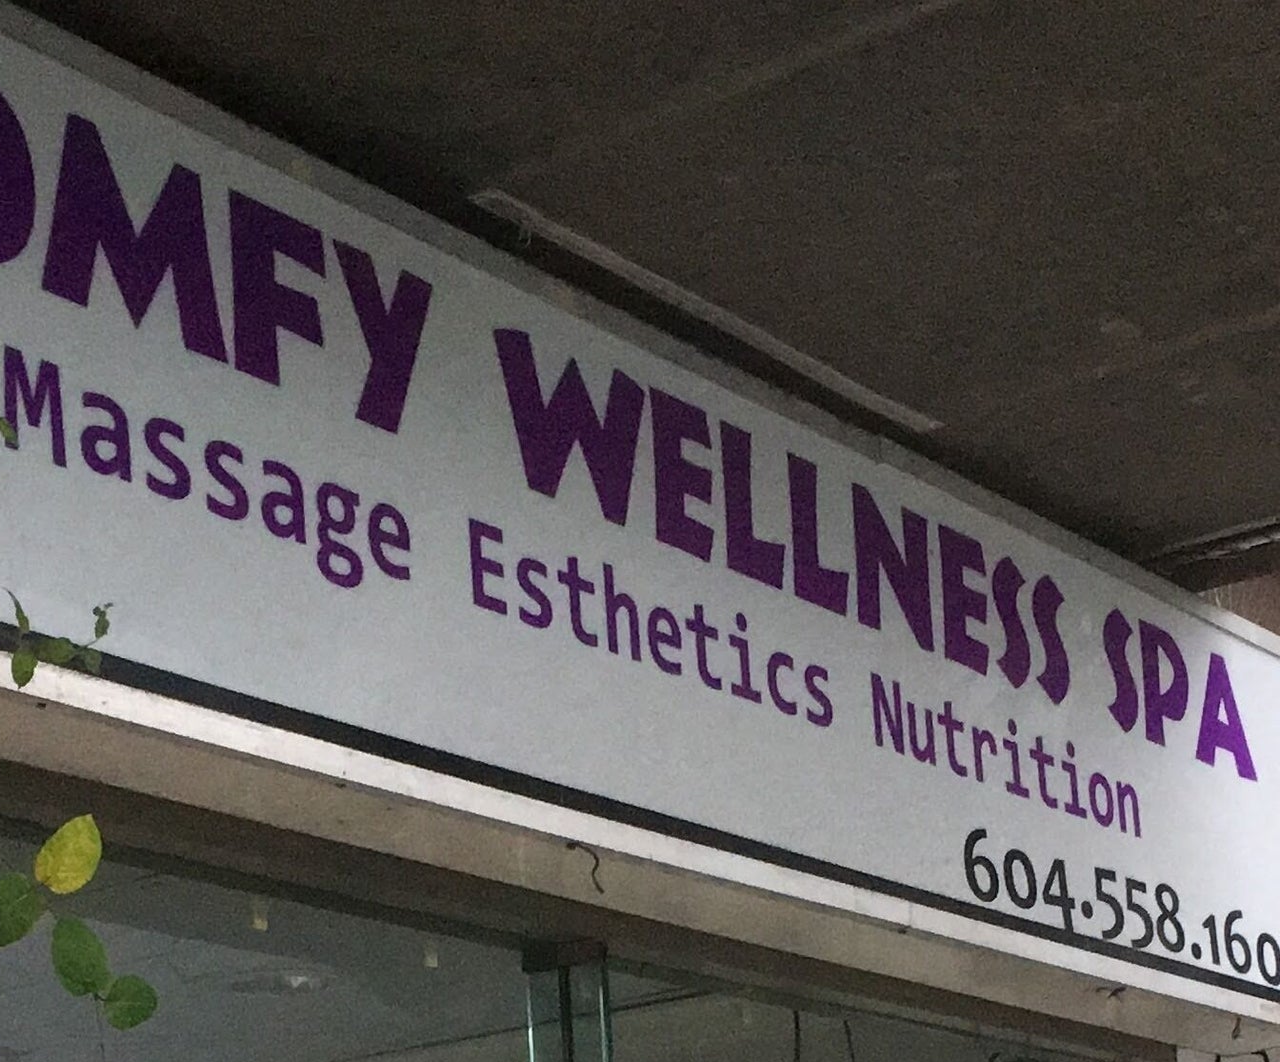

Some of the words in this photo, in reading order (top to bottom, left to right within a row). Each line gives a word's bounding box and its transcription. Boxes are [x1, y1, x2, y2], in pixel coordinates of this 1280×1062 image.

[3, 343, 411, 589] Massage
[467, 517, 835, 728] Esthetics
[871, 672, 1142, 838] Nutrition
[494, 327, 1071, 706] WELLNESS
[1104, 607, 1258, 782] SPA
